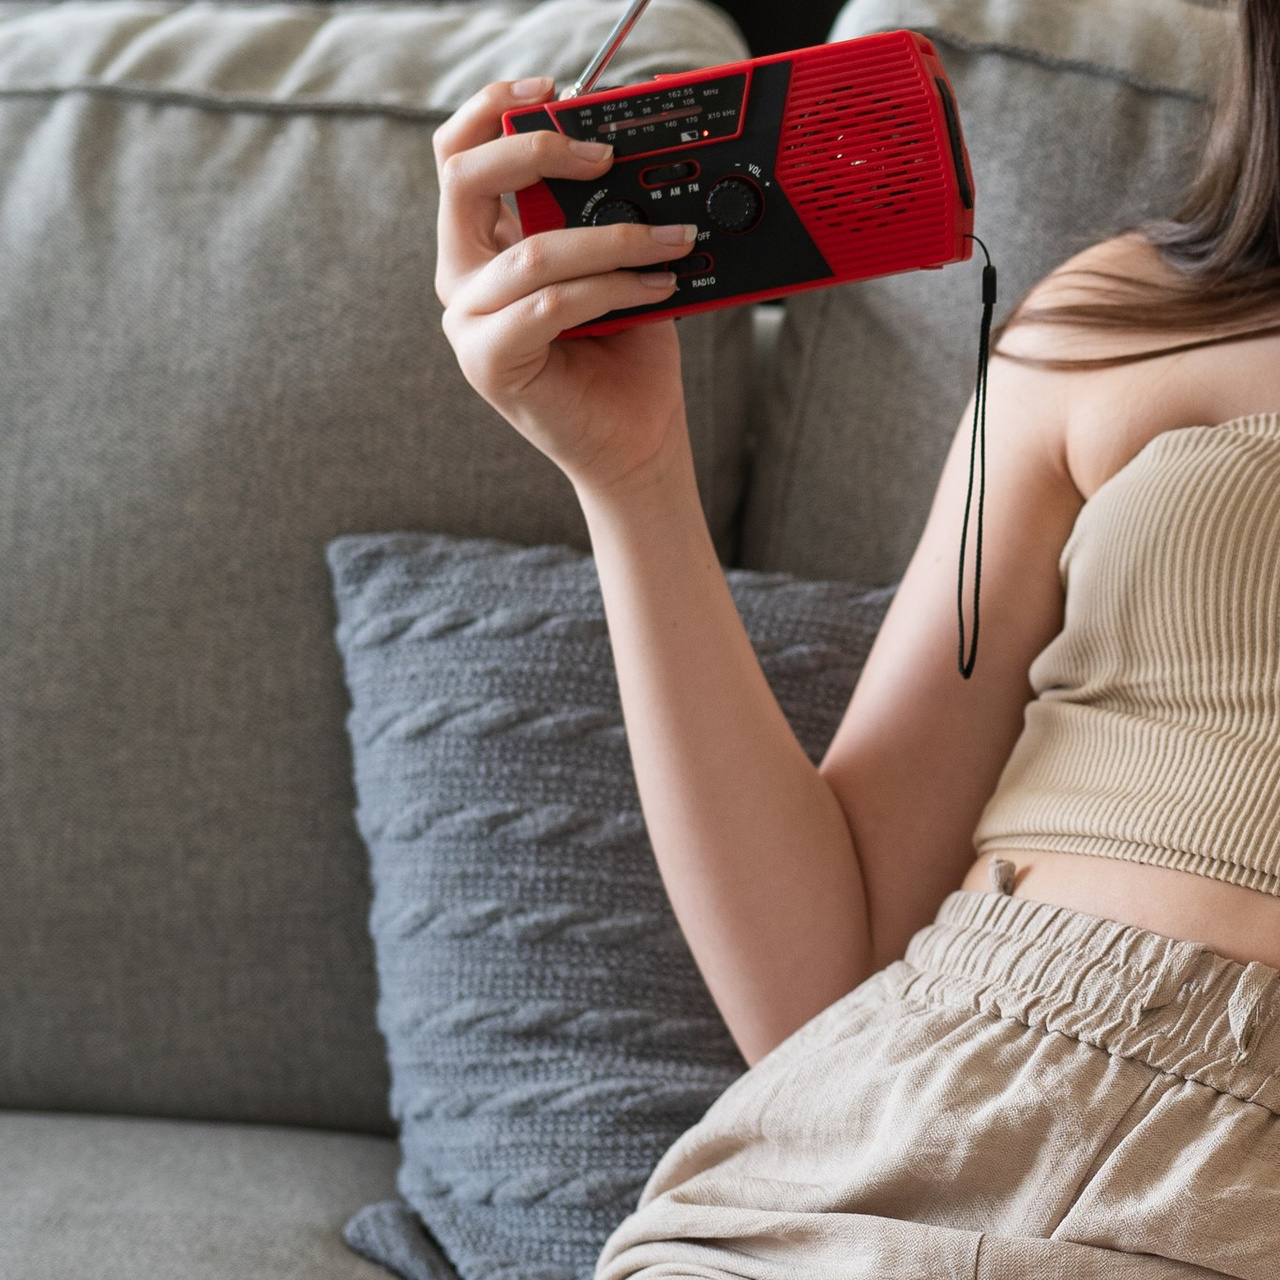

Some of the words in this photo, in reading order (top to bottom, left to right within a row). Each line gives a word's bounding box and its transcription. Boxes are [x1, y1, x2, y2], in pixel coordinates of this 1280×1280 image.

[668, 88, 694, 99] 162.55
[703, 88, 719, 96] MHz
[581, 119, 593, 127] FM
[662, 102, 675, 110] 104
[665, 121, 677, 129] 140
[708, 112, 721, 120] X10
[748, 163, 762, 178] VOL
[651, 190, 662, 200] WB
[670, 186, 681, 197] AM
[688, 183, 700, 193] FM
[582, 189, 605, 217] TUNING
[697, 231, 711, 241] OFF
[692, 277, 716, 288] RADIO
